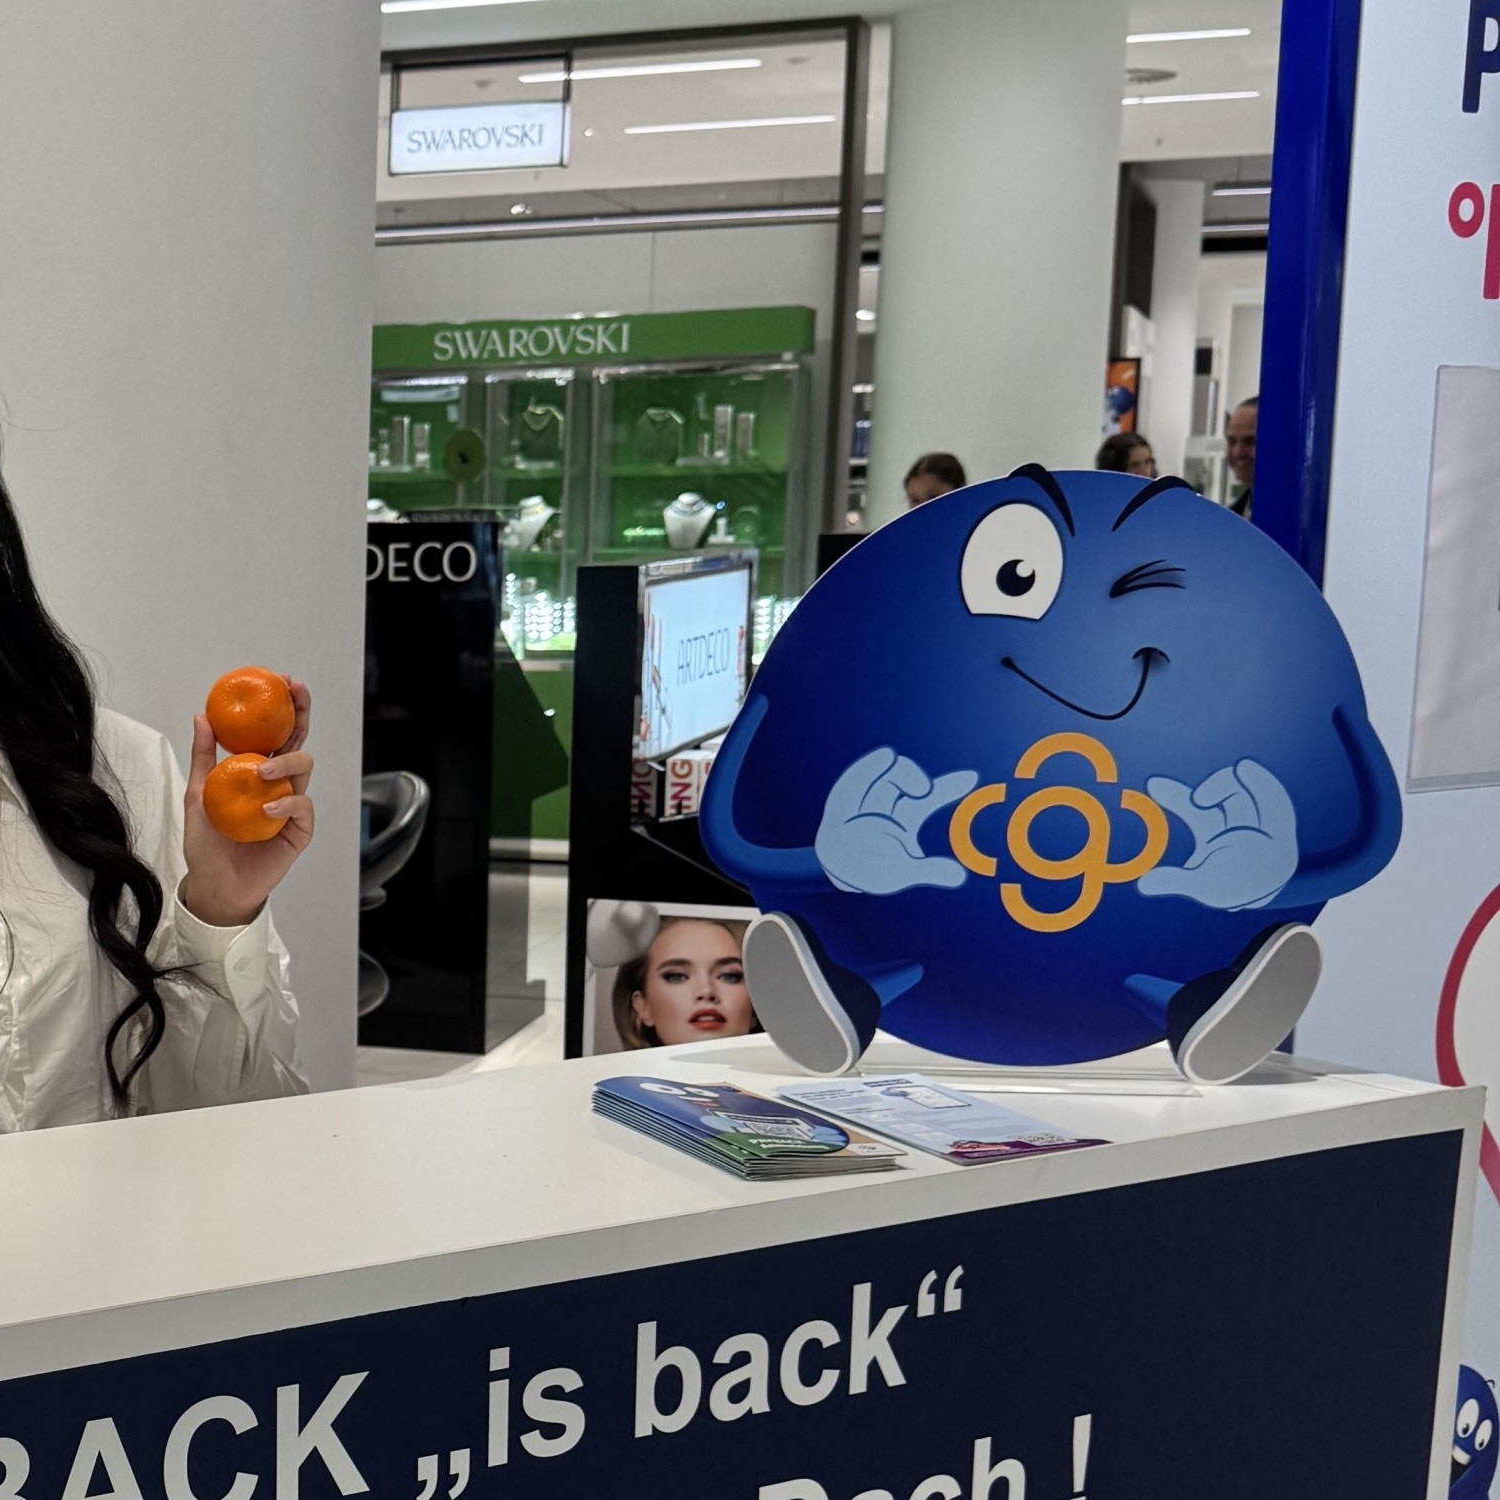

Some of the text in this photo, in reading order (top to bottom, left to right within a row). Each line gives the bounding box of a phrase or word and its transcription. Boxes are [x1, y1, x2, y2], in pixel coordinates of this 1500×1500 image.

[406, 123, 544, 154] SWAROVSKI
[433, 322, 631, 361] SWAROVSKI
[676, 627, 730, 686] ARTDECO
[634, 1265, 964, 1438] back“
